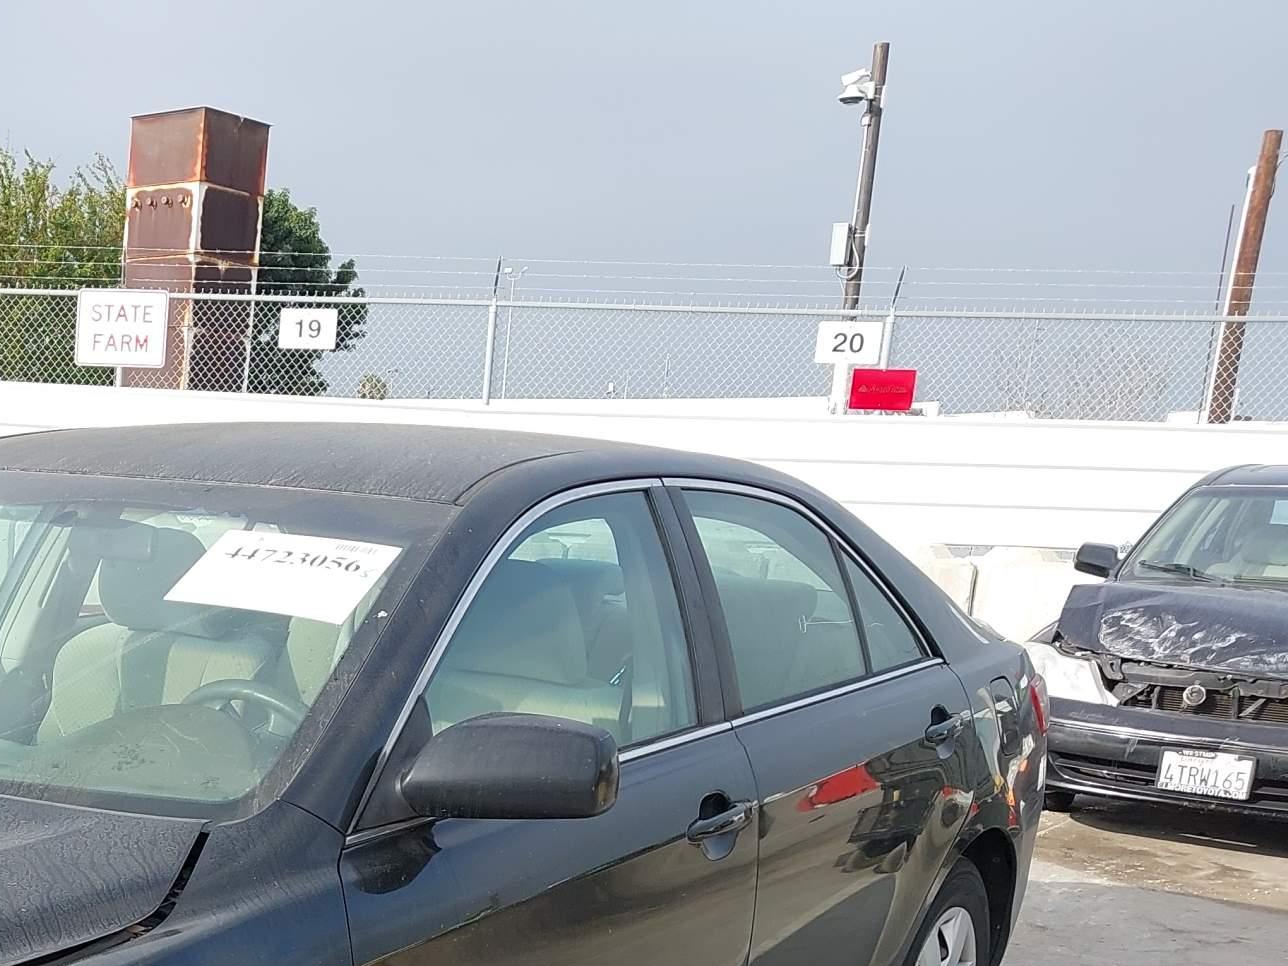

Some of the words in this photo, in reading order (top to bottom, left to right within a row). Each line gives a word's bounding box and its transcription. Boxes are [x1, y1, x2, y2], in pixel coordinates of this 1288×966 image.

[91, 304, 153, 323] STATE
[295, 319, 321, 339] 19
[92, 333, 149, 353] FARM
[831, 332, 864, 353] 20
[224, 546, 361, 572] 44723056
[1164, 763, 1247, 791] 4TRW165
